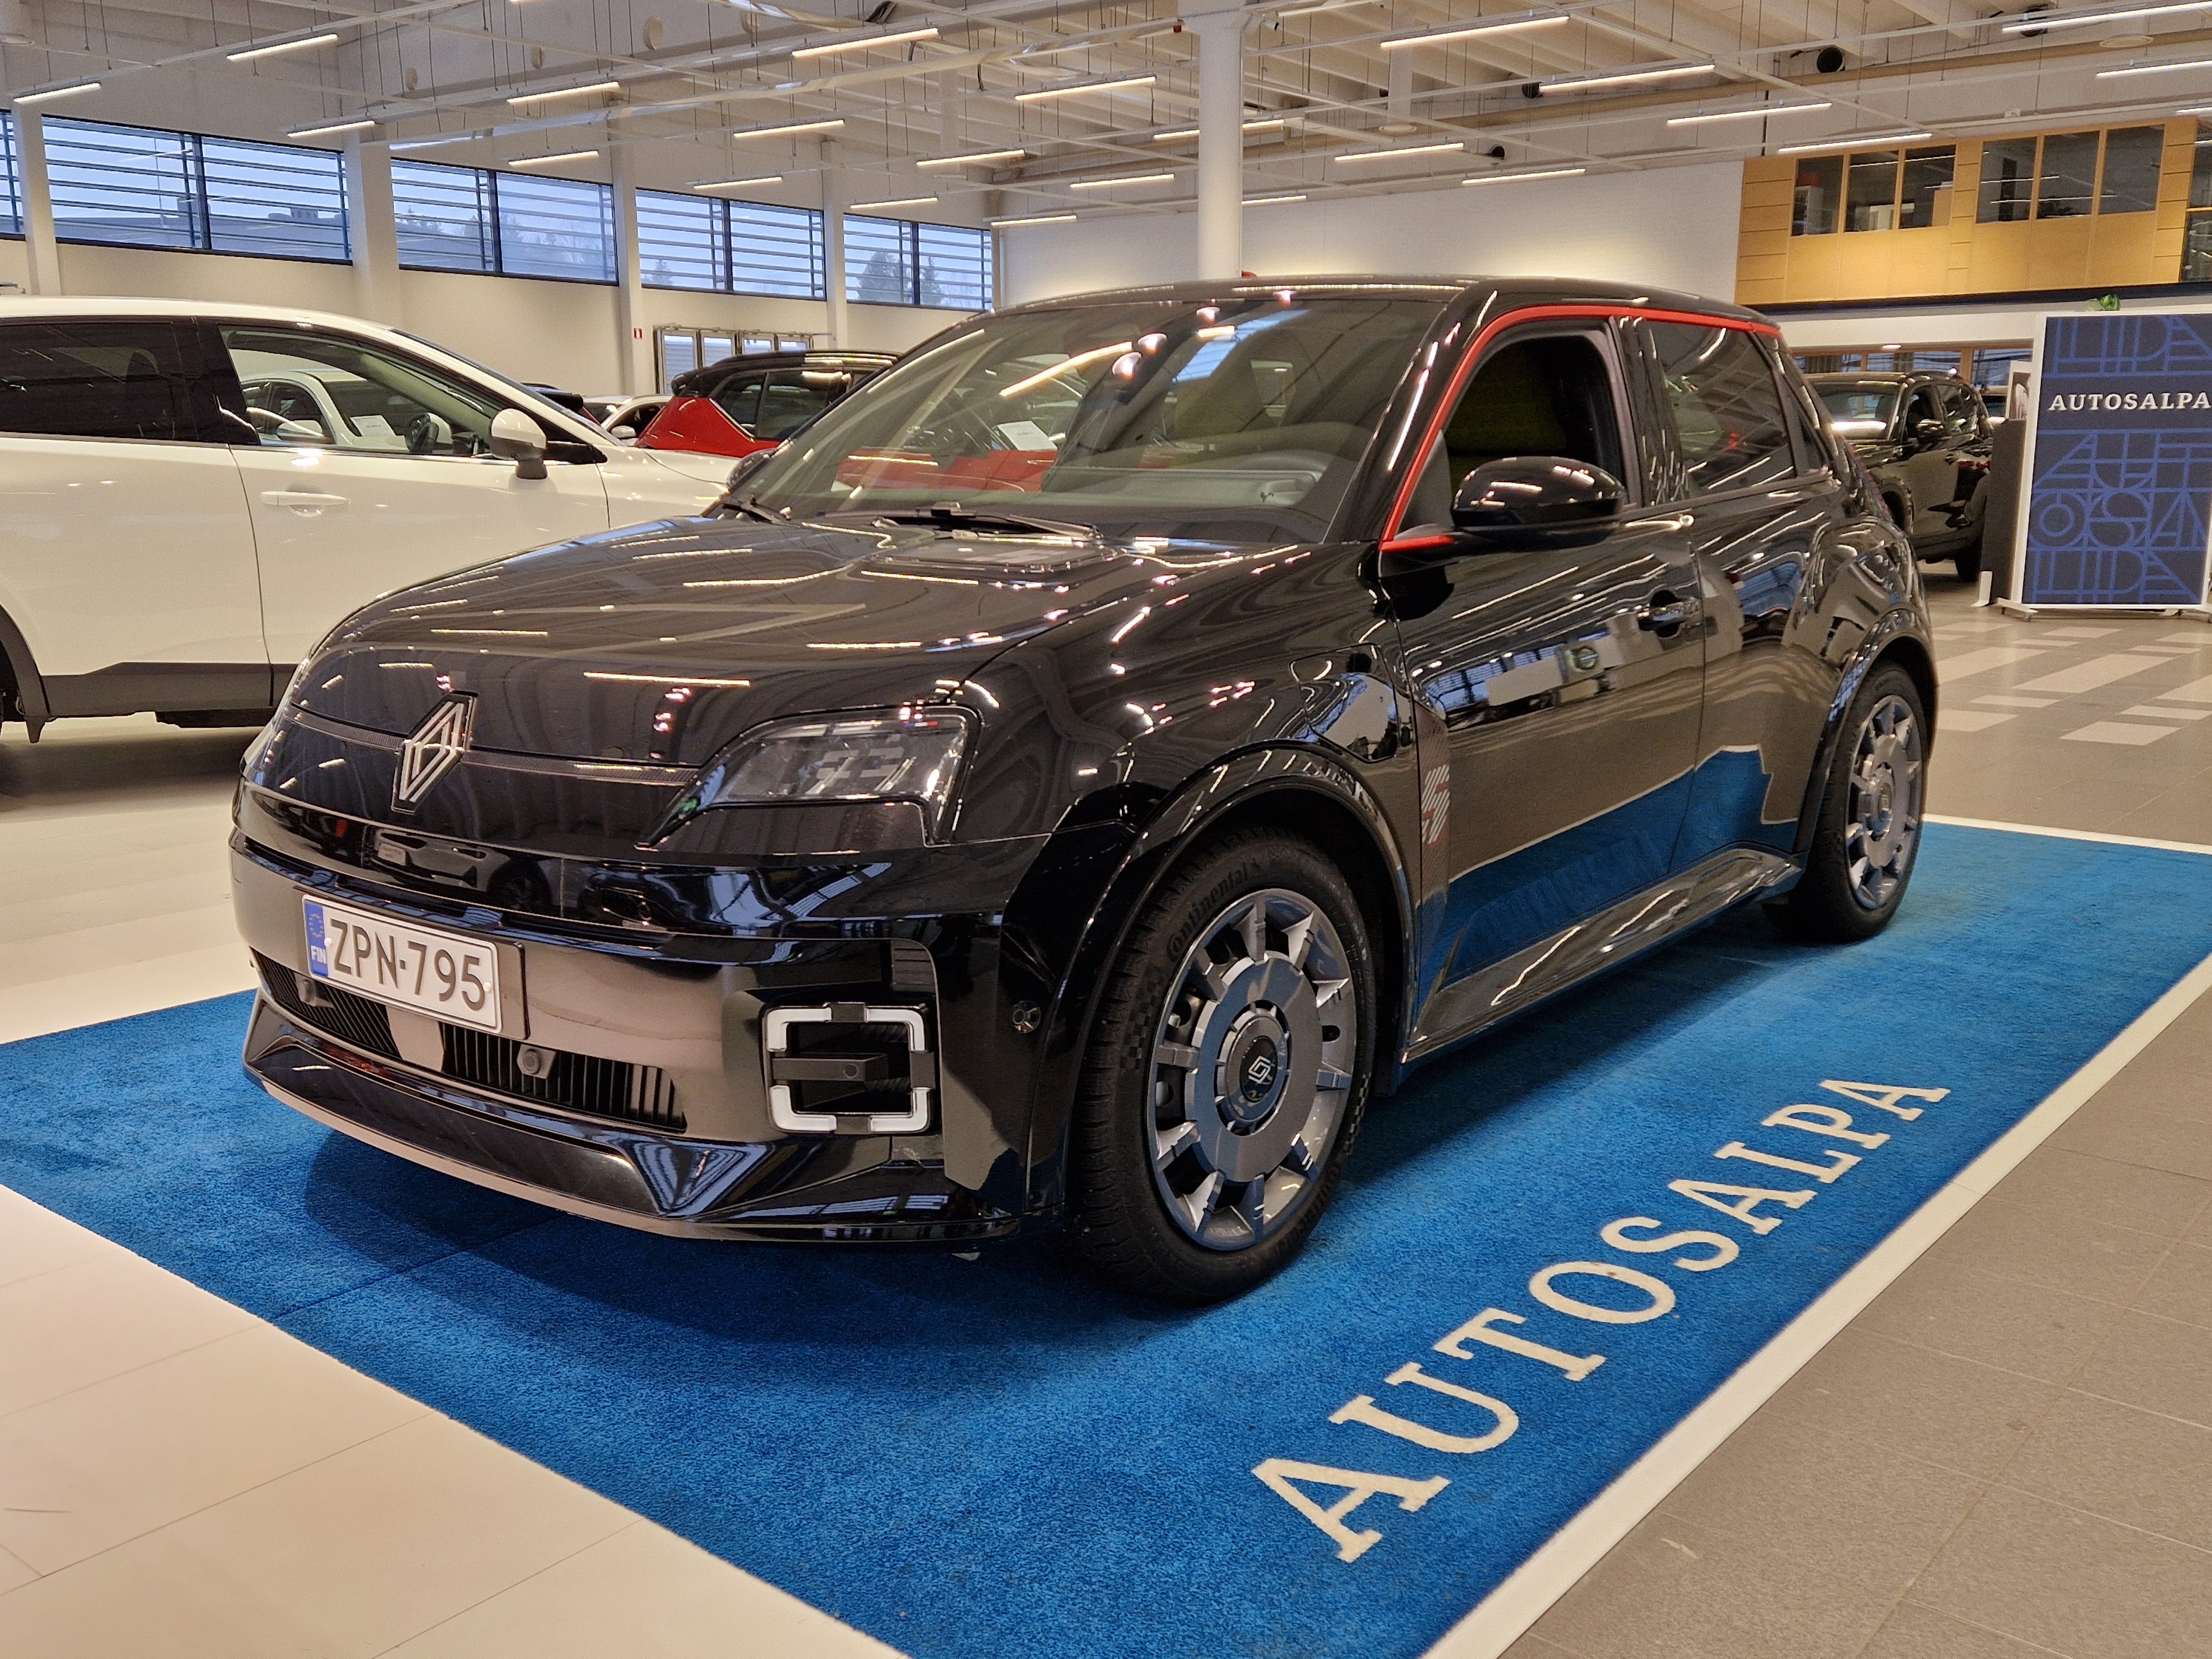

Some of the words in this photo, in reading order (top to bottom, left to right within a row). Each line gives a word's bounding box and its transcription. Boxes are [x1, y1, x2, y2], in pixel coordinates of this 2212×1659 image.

[2048, 392, 2211, 411] AUTOSALPA
[310, 945, 327, 964] FIN
[1166, 860, 1249, 963] Continental
[330, 918, 486, 1011] ZPN-795
[1251, 1078, 1951, 1563] AUTOSALPA
